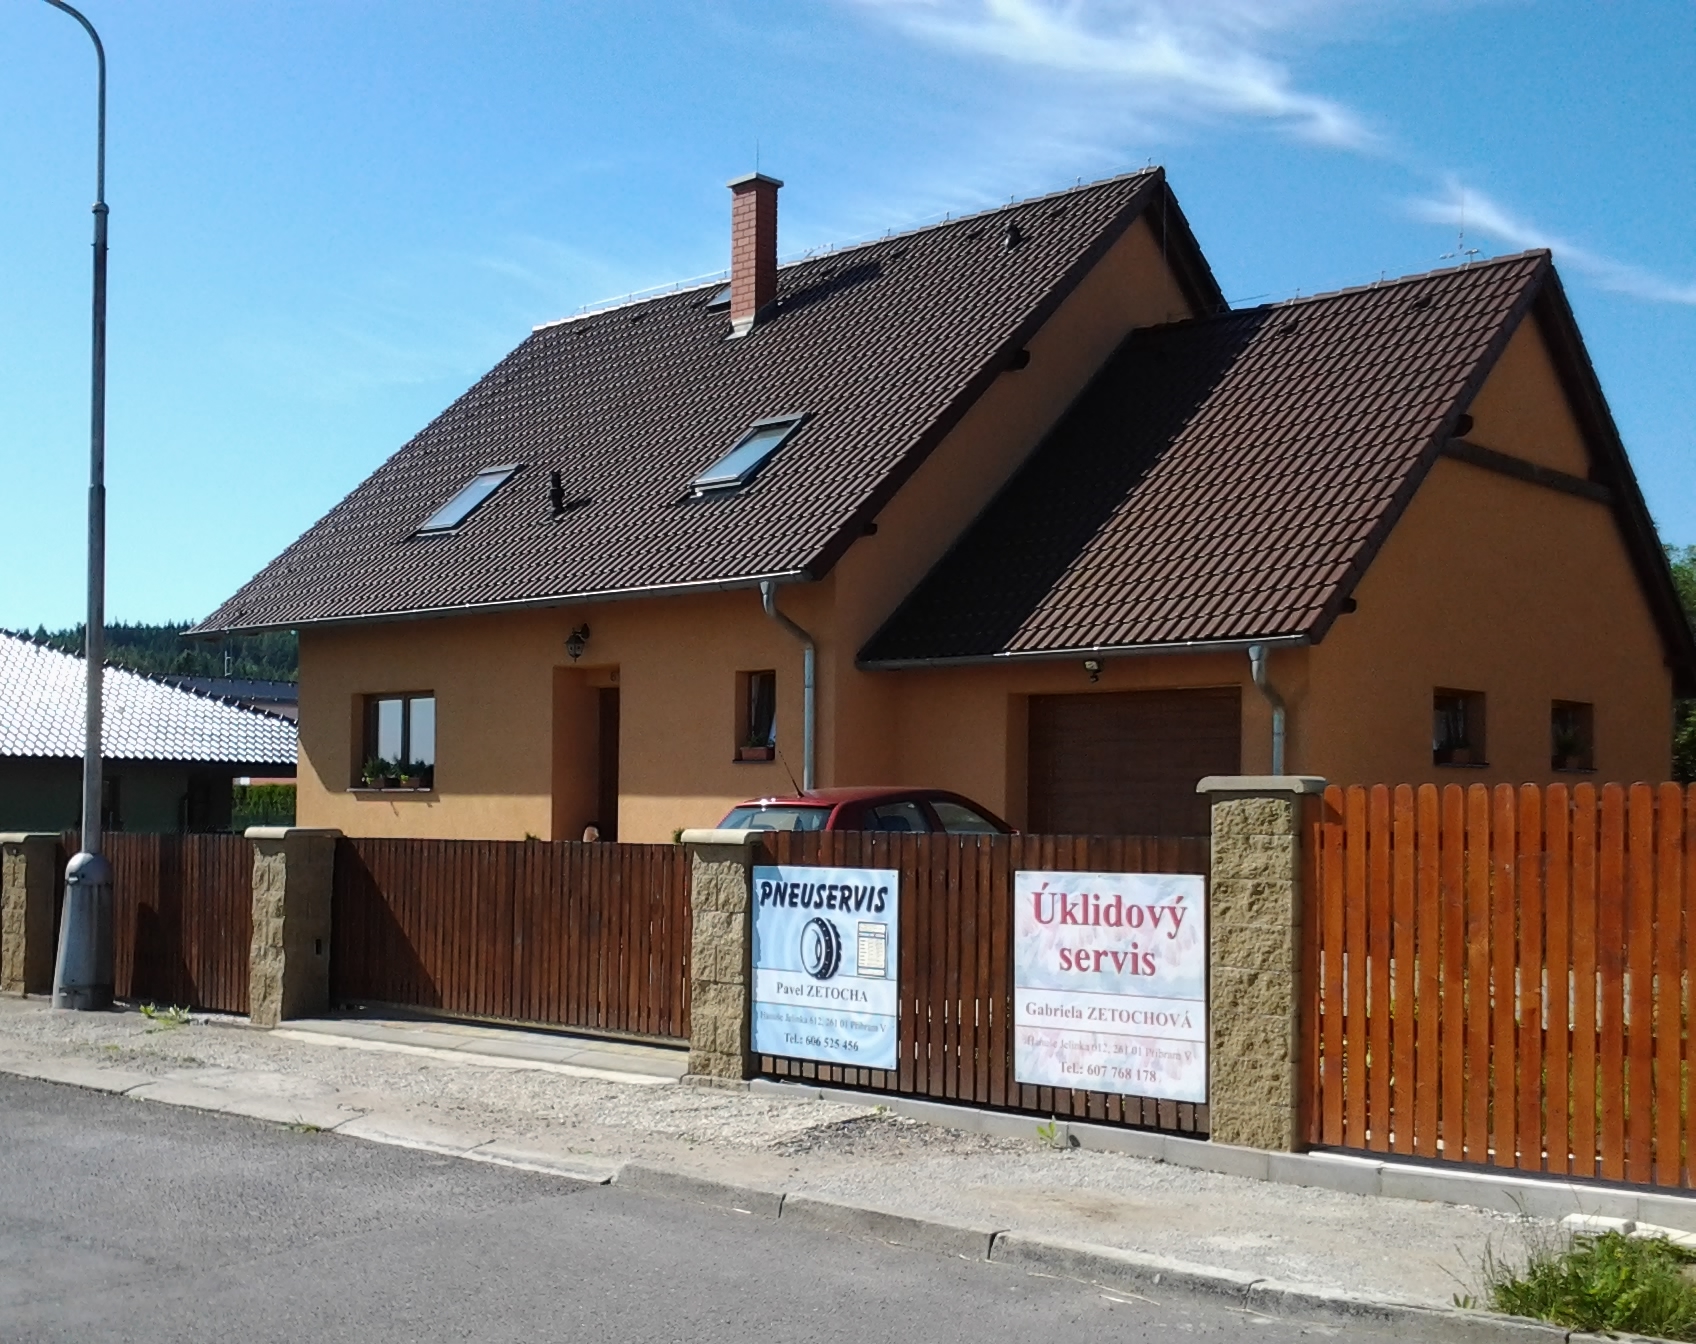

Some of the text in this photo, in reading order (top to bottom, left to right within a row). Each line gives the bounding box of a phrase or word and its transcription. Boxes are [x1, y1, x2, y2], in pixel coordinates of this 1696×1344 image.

[759, 881, 888, 913] PNEUSERVIS
[1031, 882, 1188, 940] Úklidový
[1059, 942, 1156, 976] servis
[776, 982, 868, 1003] Pavel ZETOCHA
[1025, 1001, 1192, 1029] Gabriela ZETOCHOVÁ
[805, 1036, 821, 1047] 606
[823, 1037, 840, 1049] 525
[842, 1040, 859, 1051] 456
[1087, 1064, 1108, 1077] 607
[1111, 1066, 1132, 1080] 768
[1136, 1068, 1157, 1083] 178
